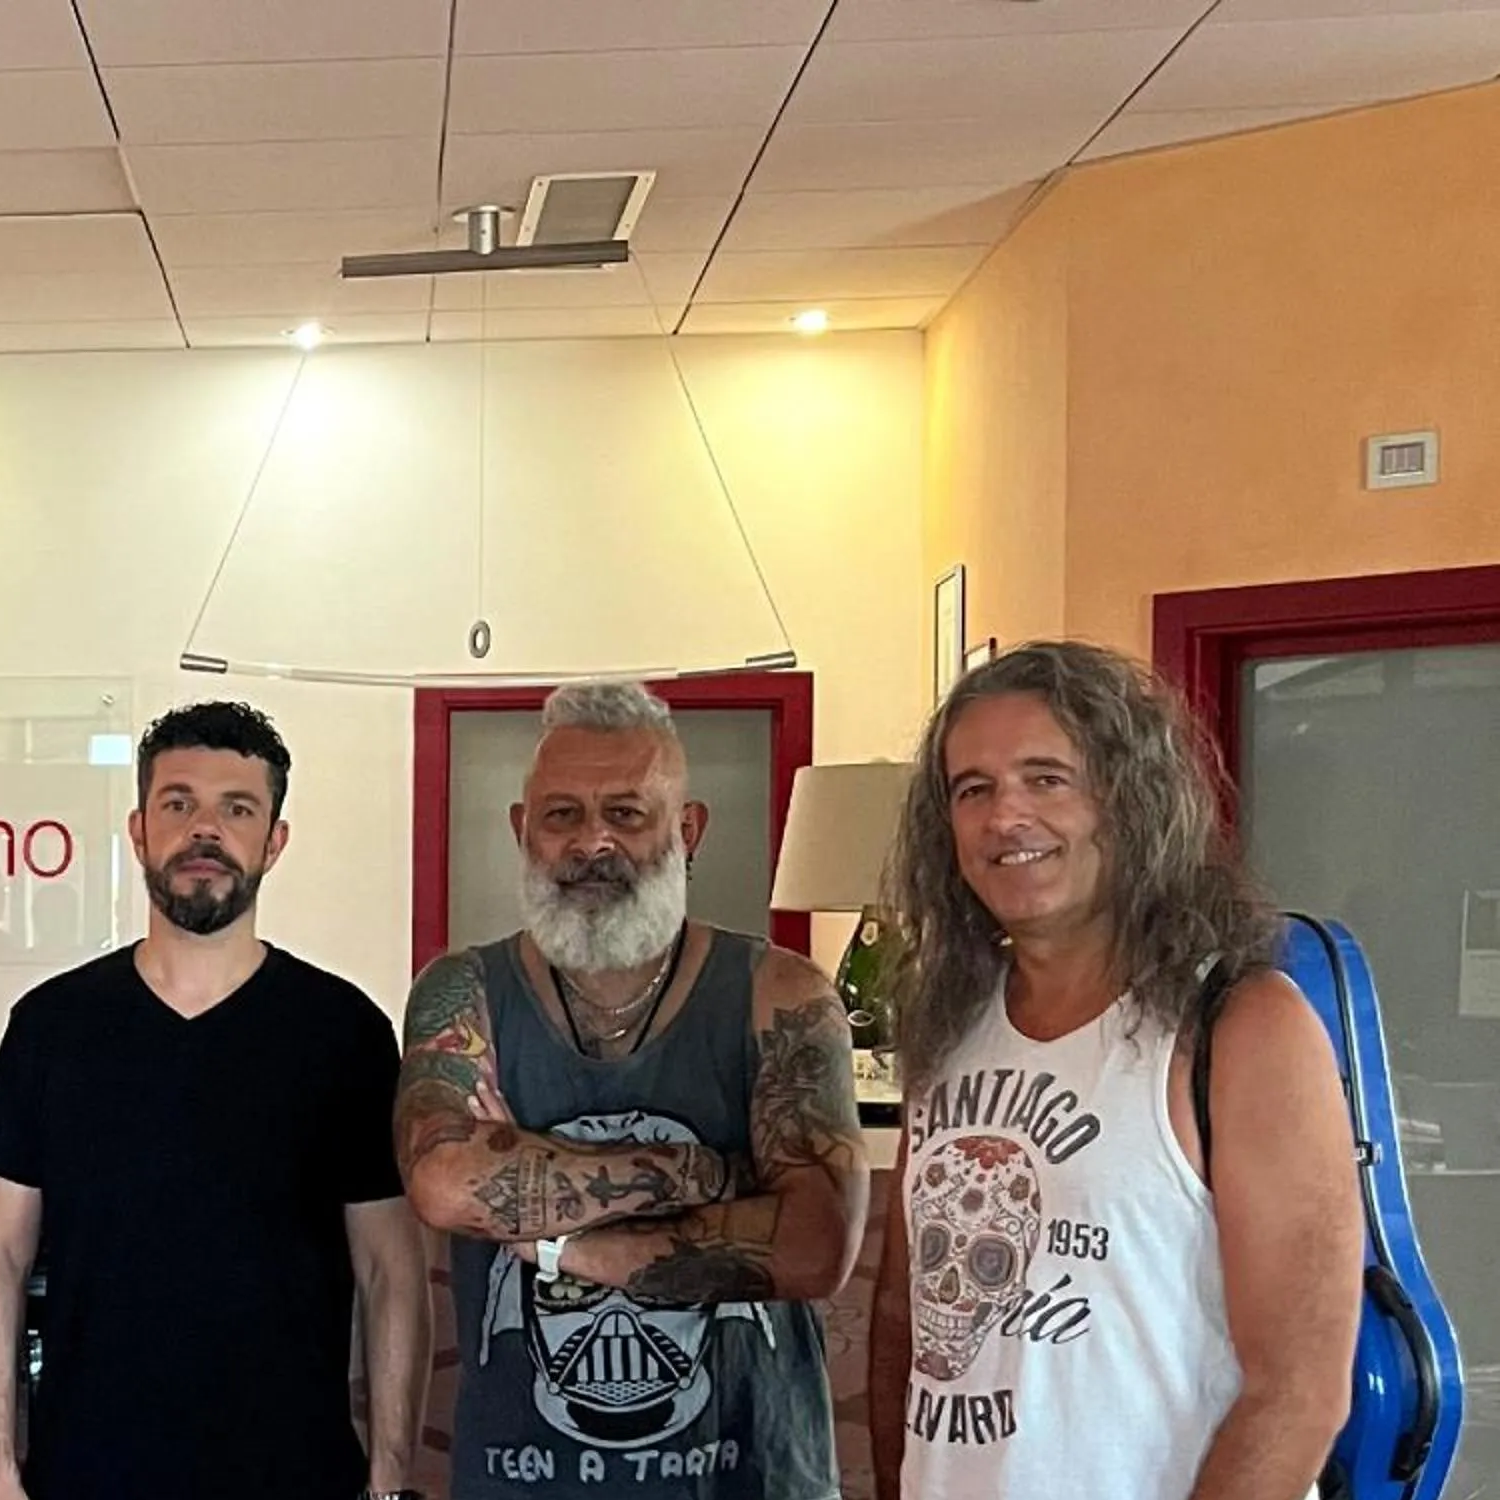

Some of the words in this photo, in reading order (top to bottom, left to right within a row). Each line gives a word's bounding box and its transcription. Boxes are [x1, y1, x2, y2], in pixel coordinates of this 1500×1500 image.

[911, 1069, 1101, 1165] SANTIAGO
[1047, 1218, 1109, 1261] 1953
[484, 1445, 555, 1482] TEEN
[580, 1450, 605, 1483] A
